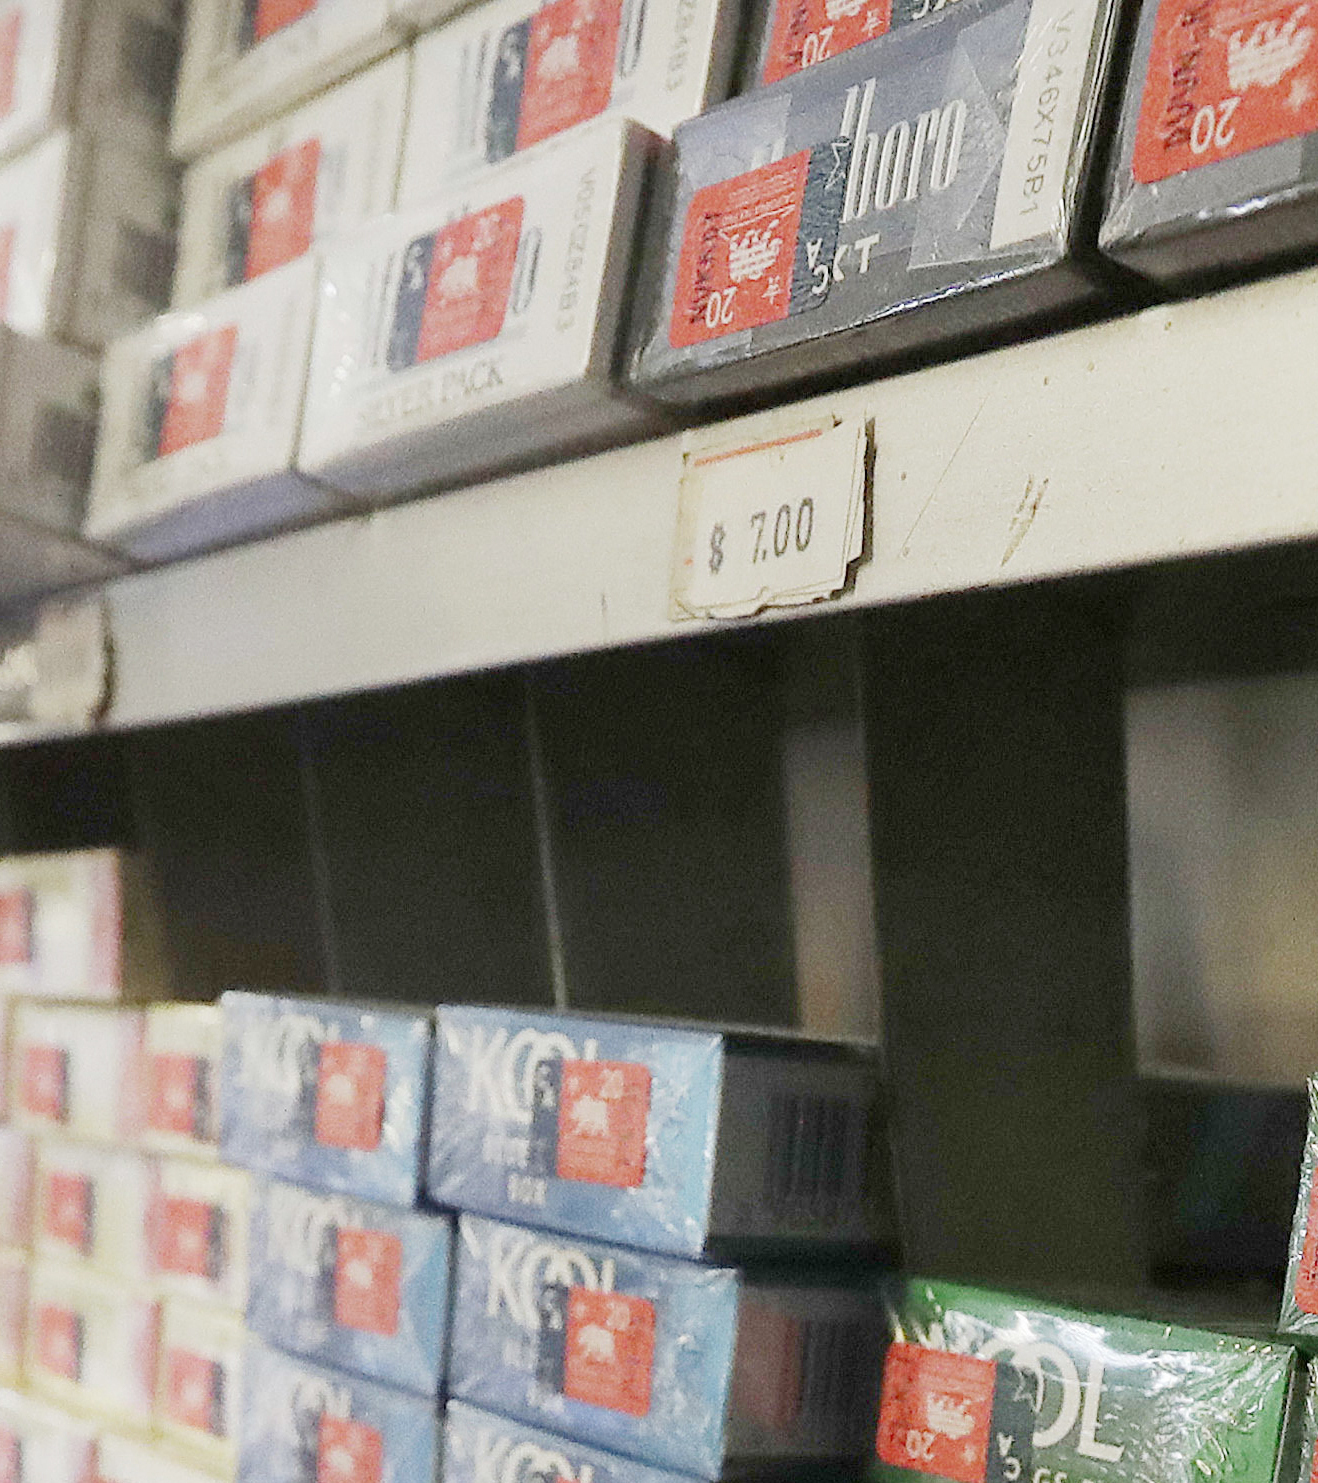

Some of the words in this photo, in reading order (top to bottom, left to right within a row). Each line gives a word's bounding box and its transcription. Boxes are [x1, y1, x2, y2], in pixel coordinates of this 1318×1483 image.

[1189, 96, 1241, 155] 20
[704, 284, 738, 330] 20
[750, 497, 814, 565] 7.00
